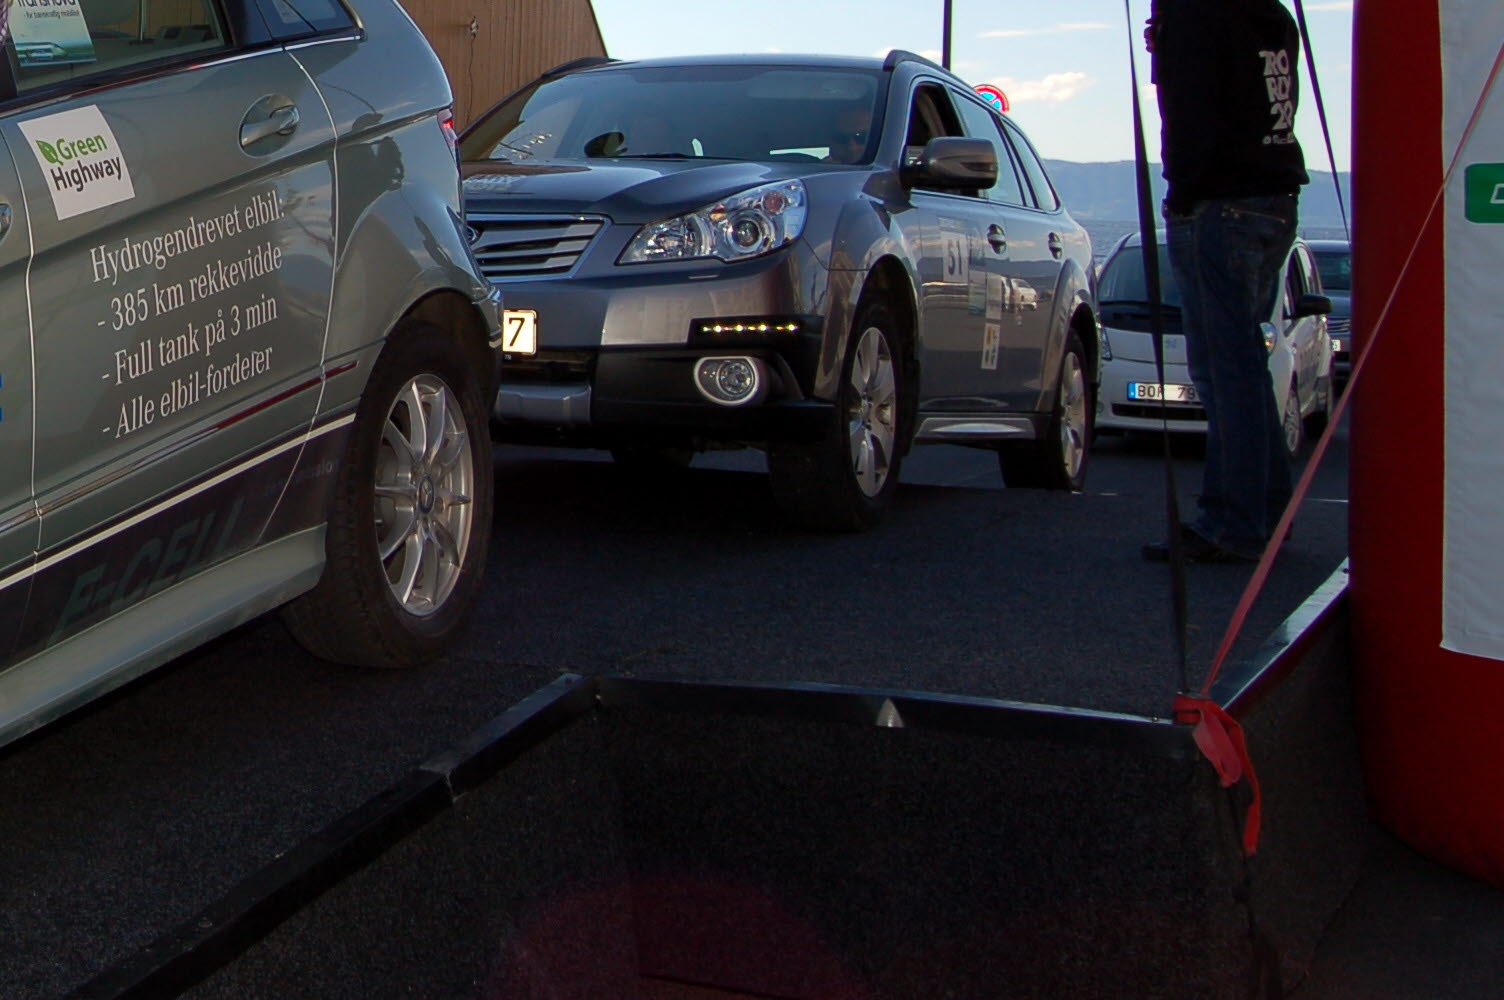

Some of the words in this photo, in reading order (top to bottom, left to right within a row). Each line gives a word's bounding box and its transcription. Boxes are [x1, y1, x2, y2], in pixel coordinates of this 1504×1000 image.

[57, 132, 108, 162] Green
[50, 156, 123, 192] Highway
[89, 204, 243, 286] Hydrogendrevet
[111, 288, 149, 331] 385
[152, 281, 185, 316] km
[189, 241, 283, 303] rekkevidde
[114, 340, 152, 386] Full
[159, 323, 200, 367] tank
[205, 310, 226, 356] på
[230, 305, 241, 336] 3
[246, 294, 278, 331] min
[508, 317, 525, 347] 7
[114, 395, 155, 439] Alle
